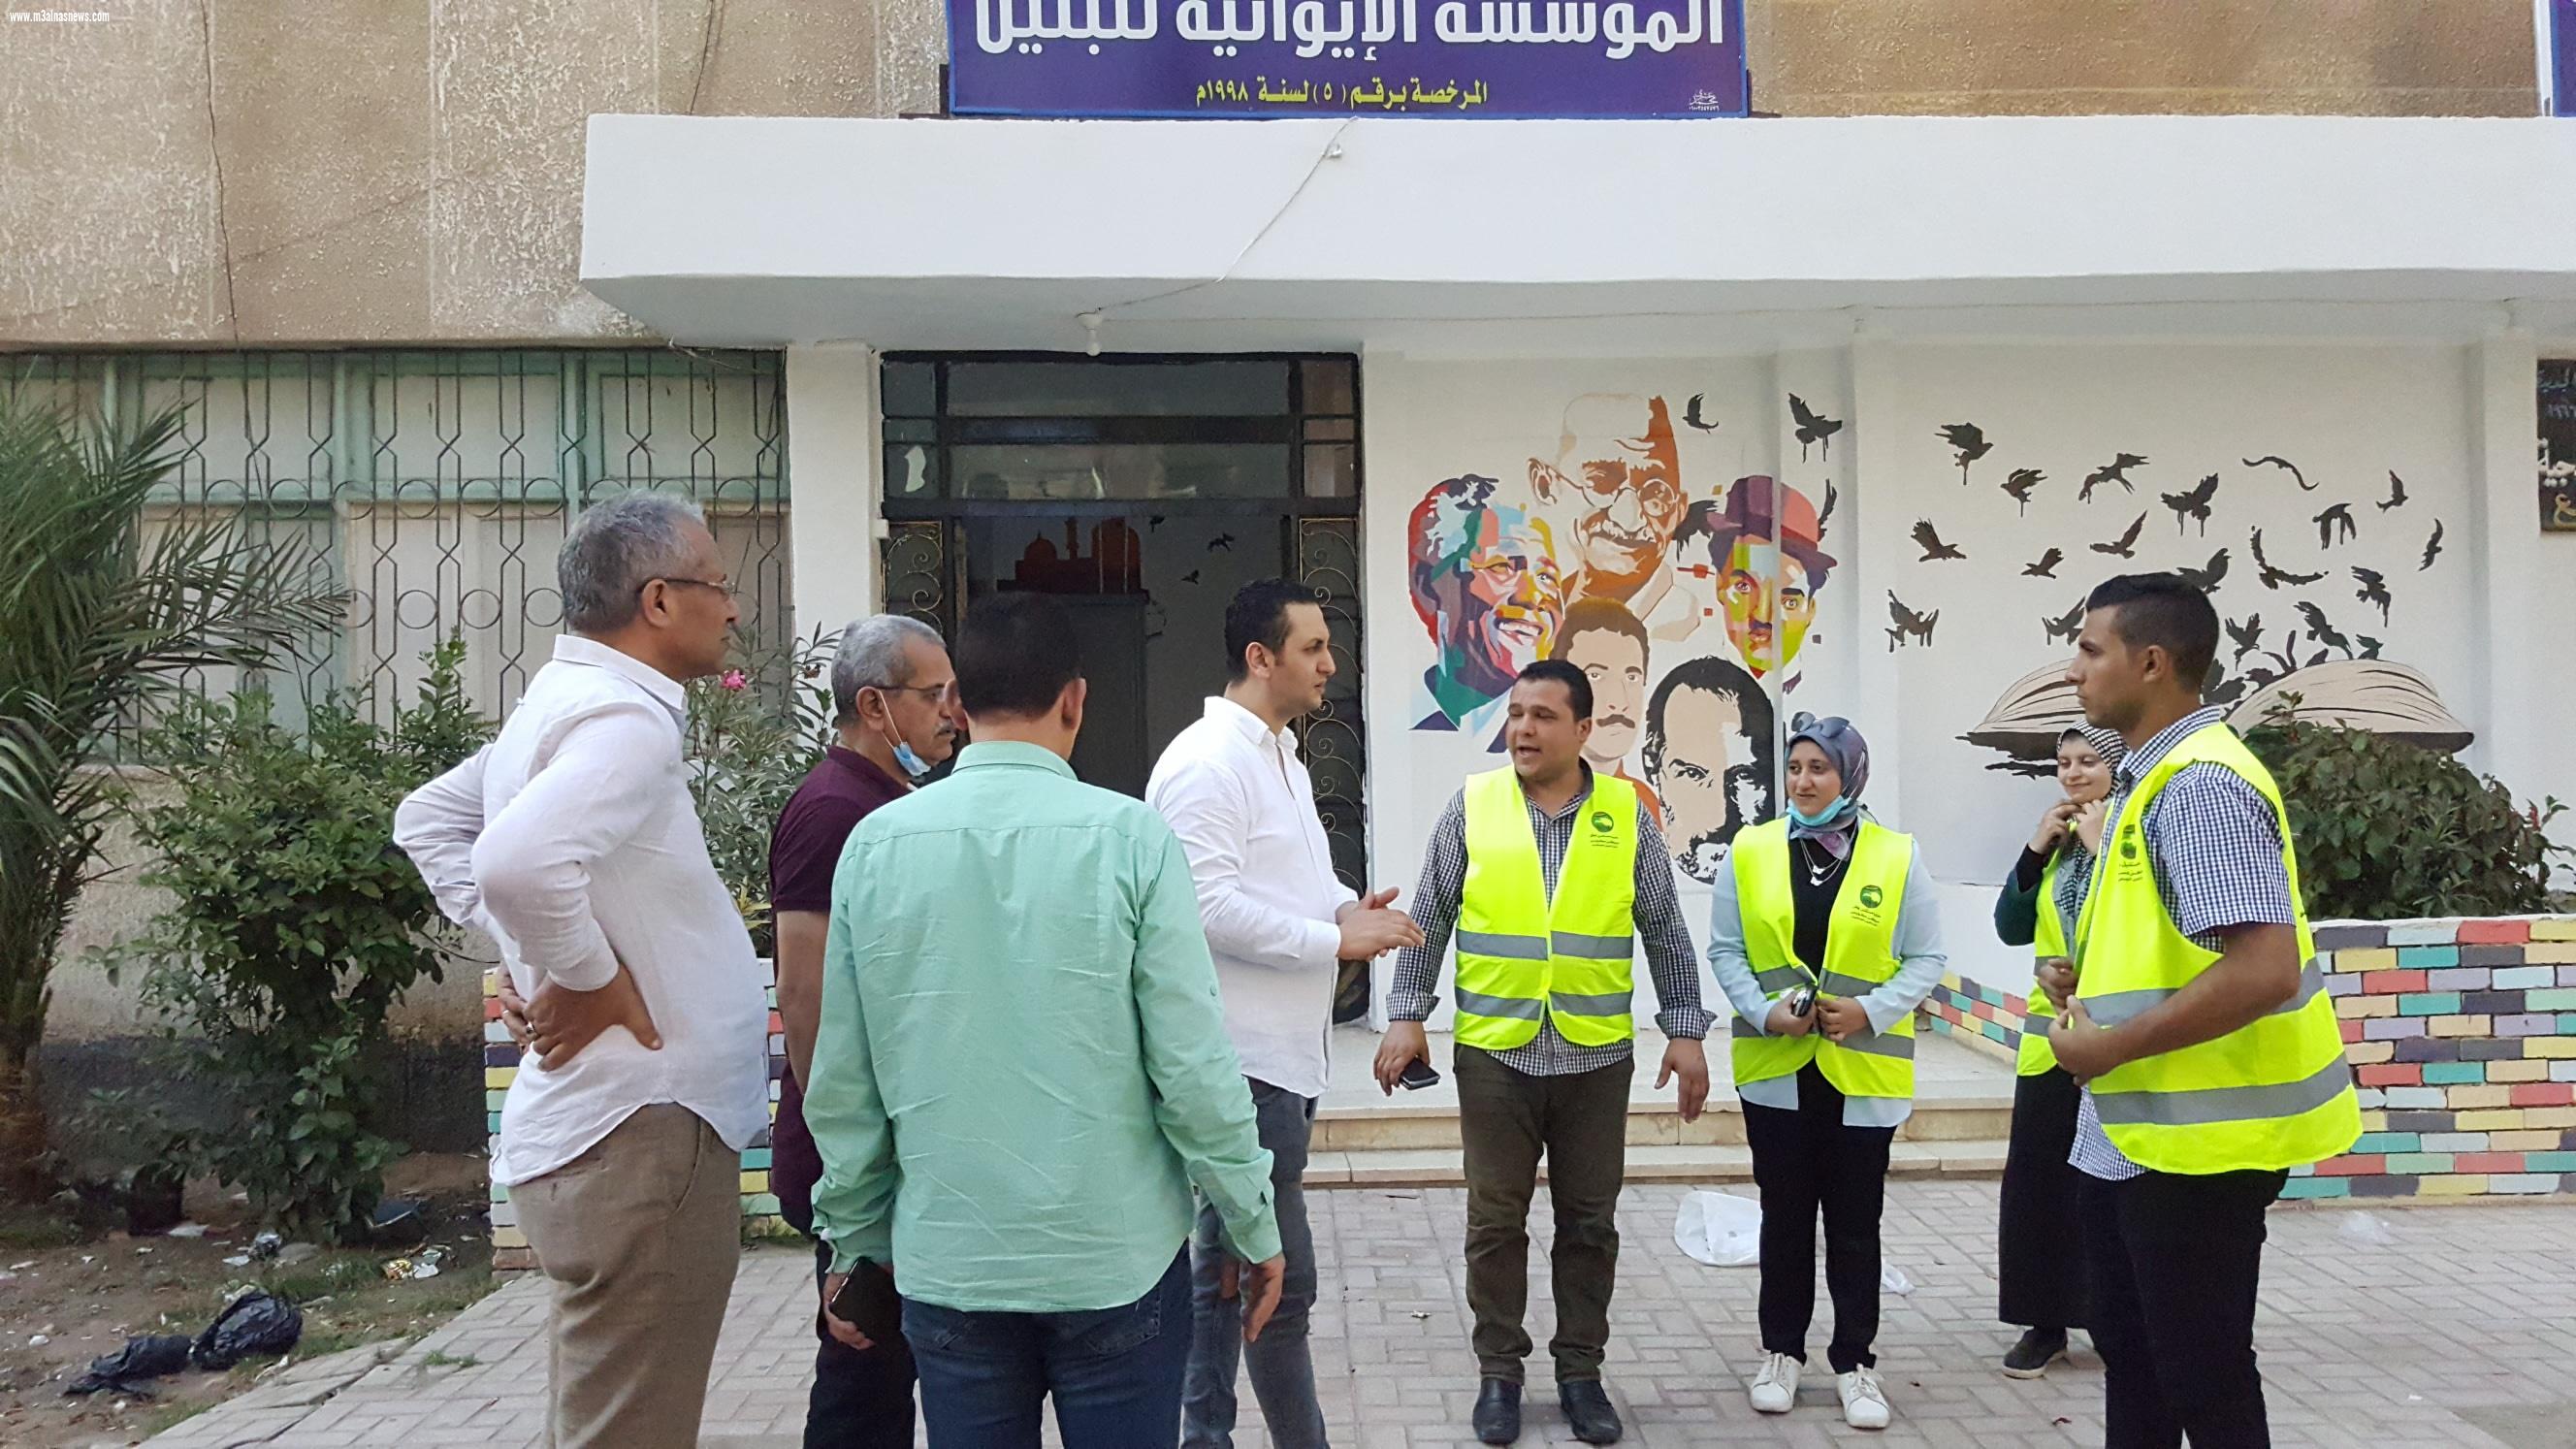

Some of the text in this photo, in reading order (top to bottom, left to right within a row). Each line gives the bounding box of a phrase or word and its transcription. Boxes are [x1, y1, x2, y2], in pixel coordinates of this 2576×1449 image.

[1257, 76, 1309, 103] لسنة
[1350, 77, 1407, 112] برقم
[1411, 77, 1487, 110] المرخصة
